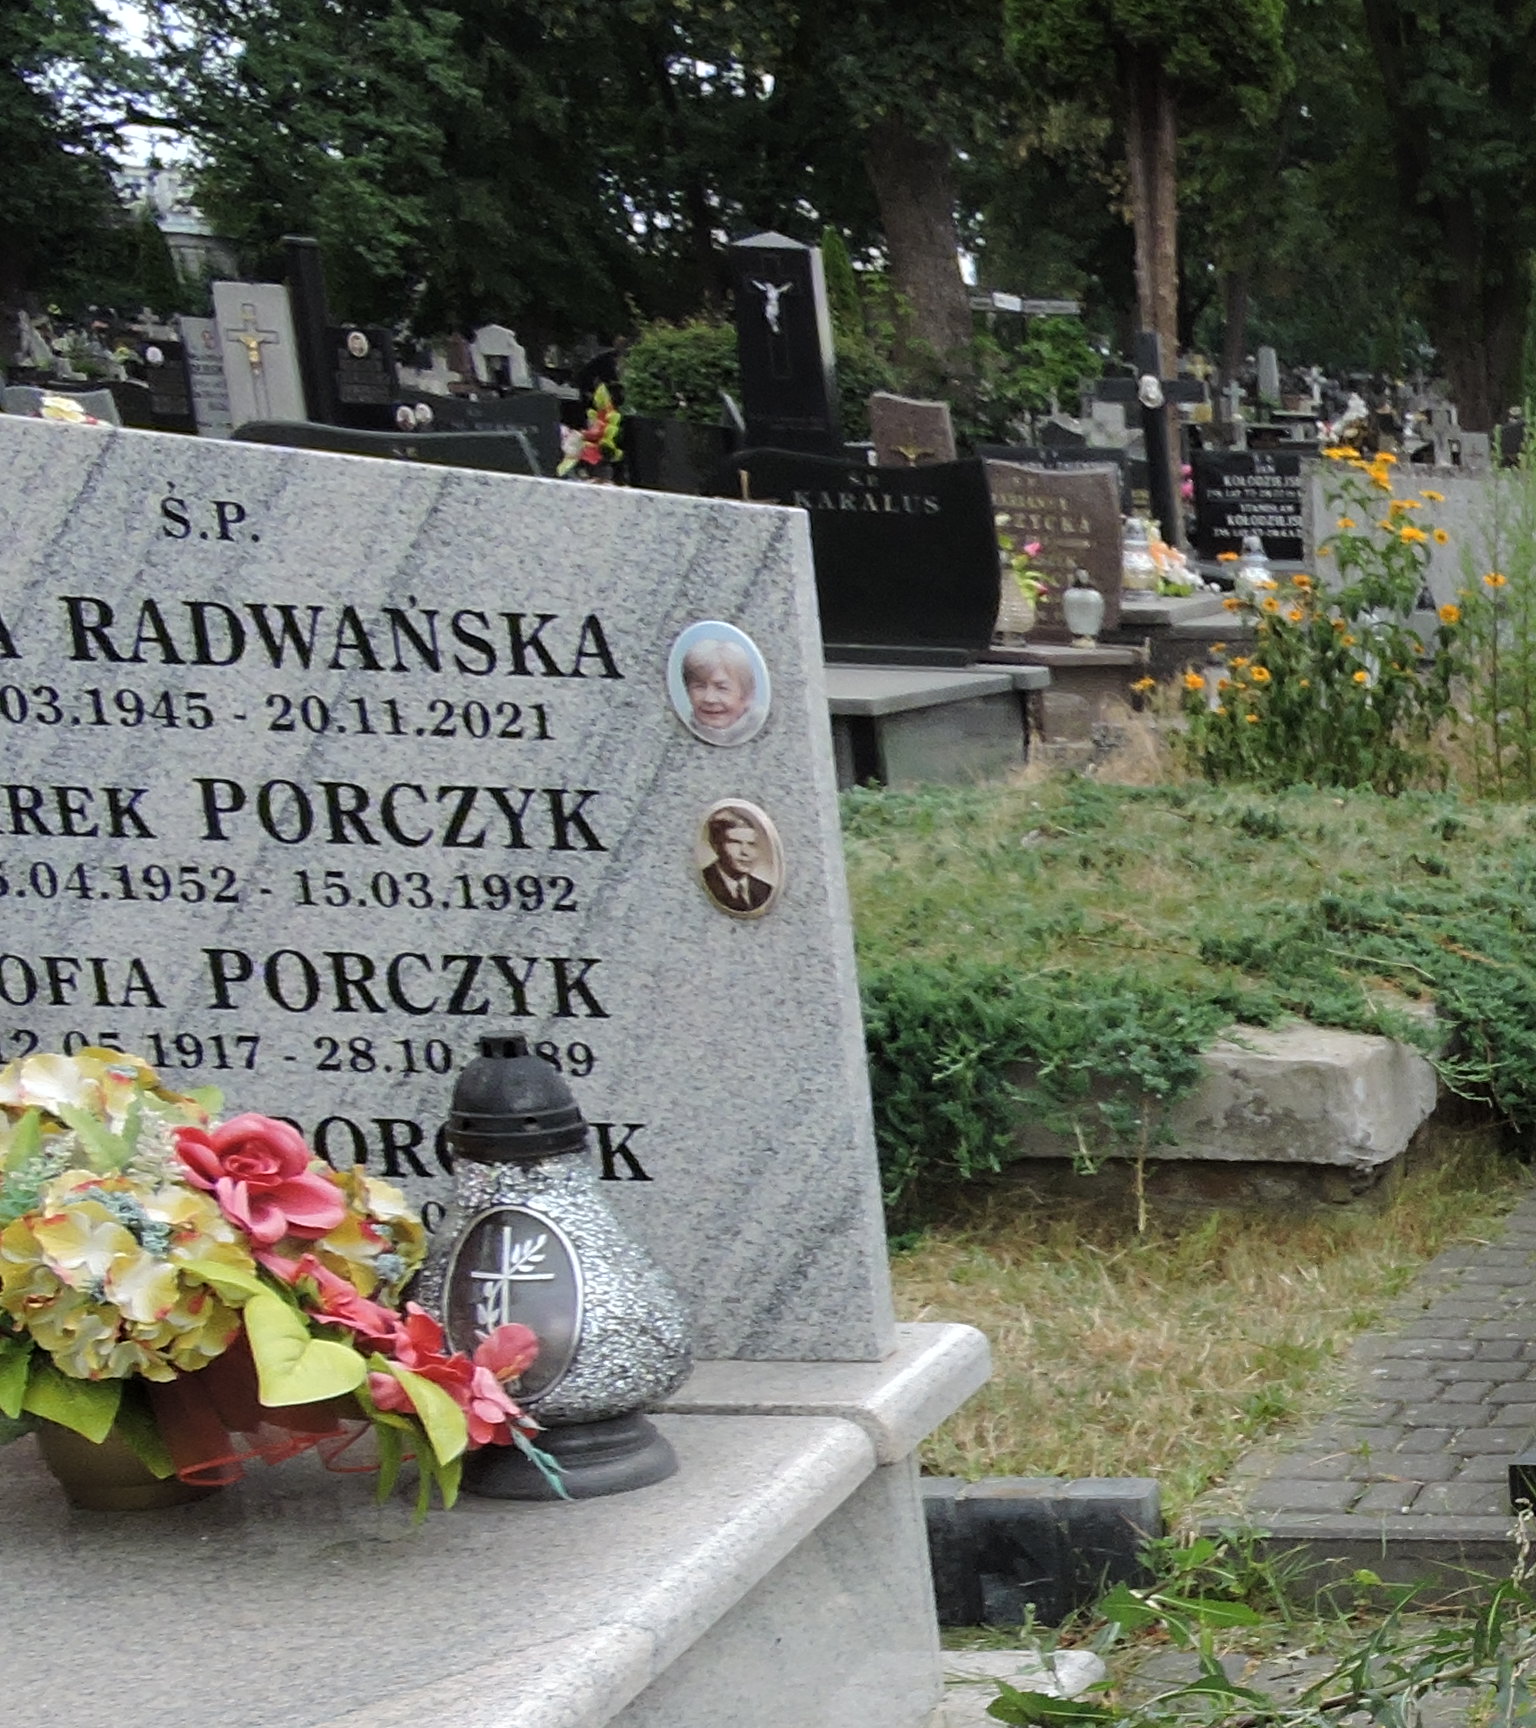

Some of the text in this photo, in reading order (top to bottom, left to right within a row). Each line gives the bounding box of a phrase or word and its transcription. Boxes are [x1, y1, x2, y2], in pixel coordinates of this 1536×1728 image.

[792, 489, 941, 514] KARALUS
[58, 594, 625, 680] RADWAŃSKA
[0, 684, 214, 730] 03.1945
[266, 692, 555, 741] 20.11.2021
[0, 777, 609, 853] REK PORCZYK
[298, 868, 579, 913] 15.03.1992
[201, 948, 611, 1019] PORCZYK
